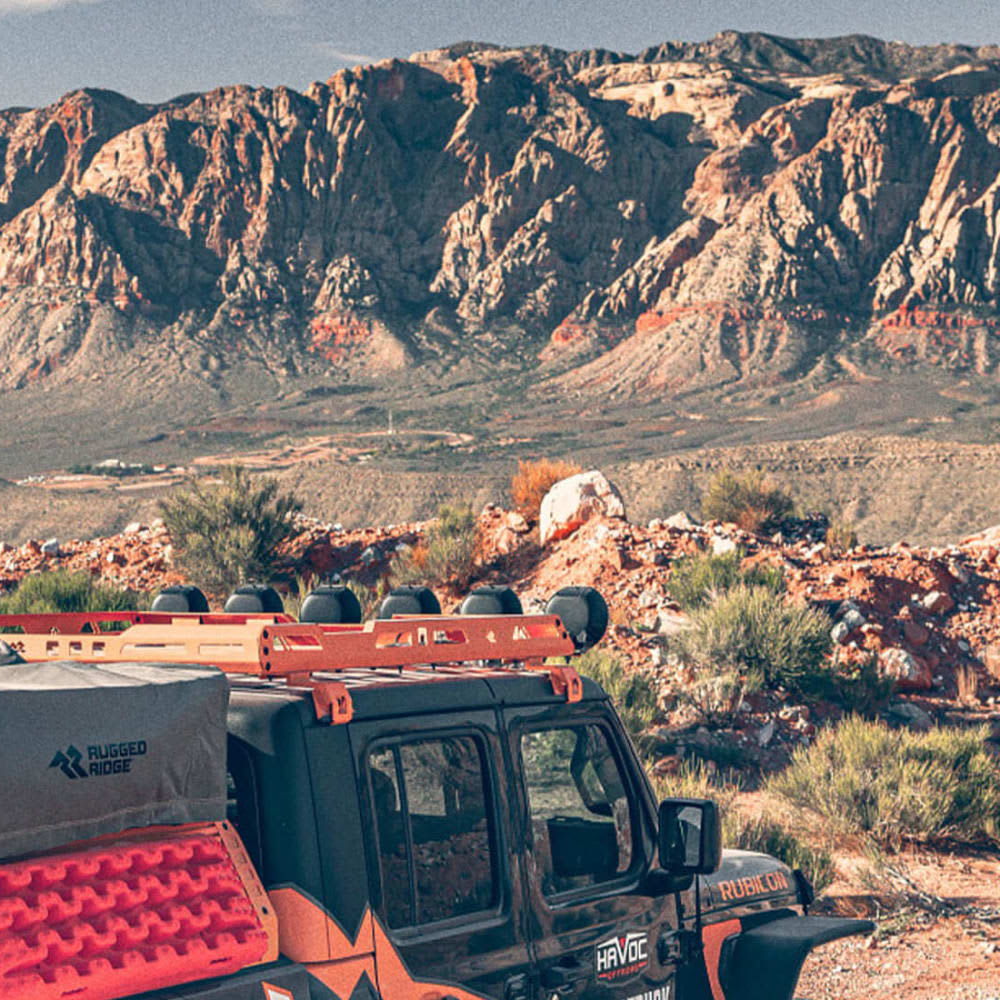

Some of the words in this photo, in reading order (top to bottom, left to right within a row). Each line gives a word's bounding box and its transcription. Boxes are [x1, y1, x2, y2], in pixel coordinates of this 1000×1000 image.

[88, 740, 147, 761] RUGGED
[89, 758, 132, 777] RIDGE
[718, 871, 789, 901] RUBICON
[597, 932, 648, 972] HAVOC
